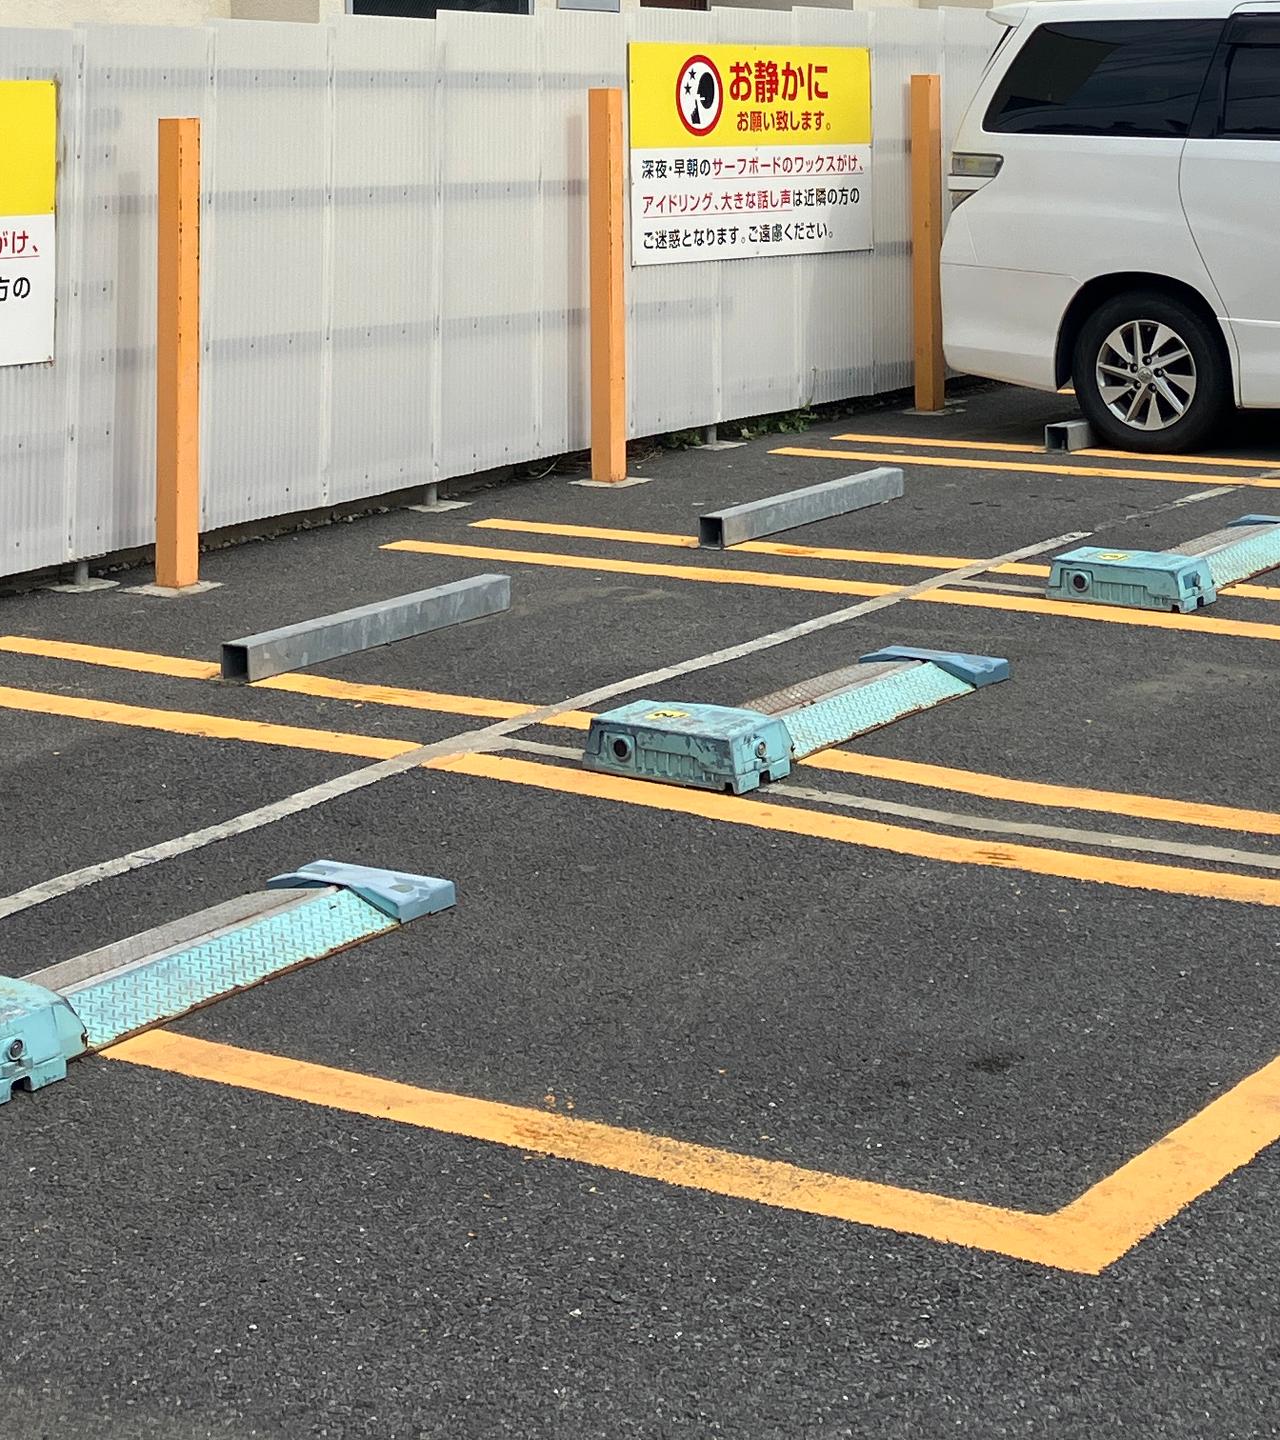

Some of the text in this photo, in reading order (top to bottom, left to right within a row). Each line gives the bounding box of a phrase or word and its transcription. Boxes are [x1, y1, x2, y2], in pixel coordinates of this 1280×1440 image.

[728, 60, 829, 103] お静かに
[736, 111, 832, 132] お願い致します。
[641, 187, 860, 214] アイドリング、大きな話し声は近隣の方の
[642, 222, 834, 250] ご迷惑となります。ご遠慮ください。
